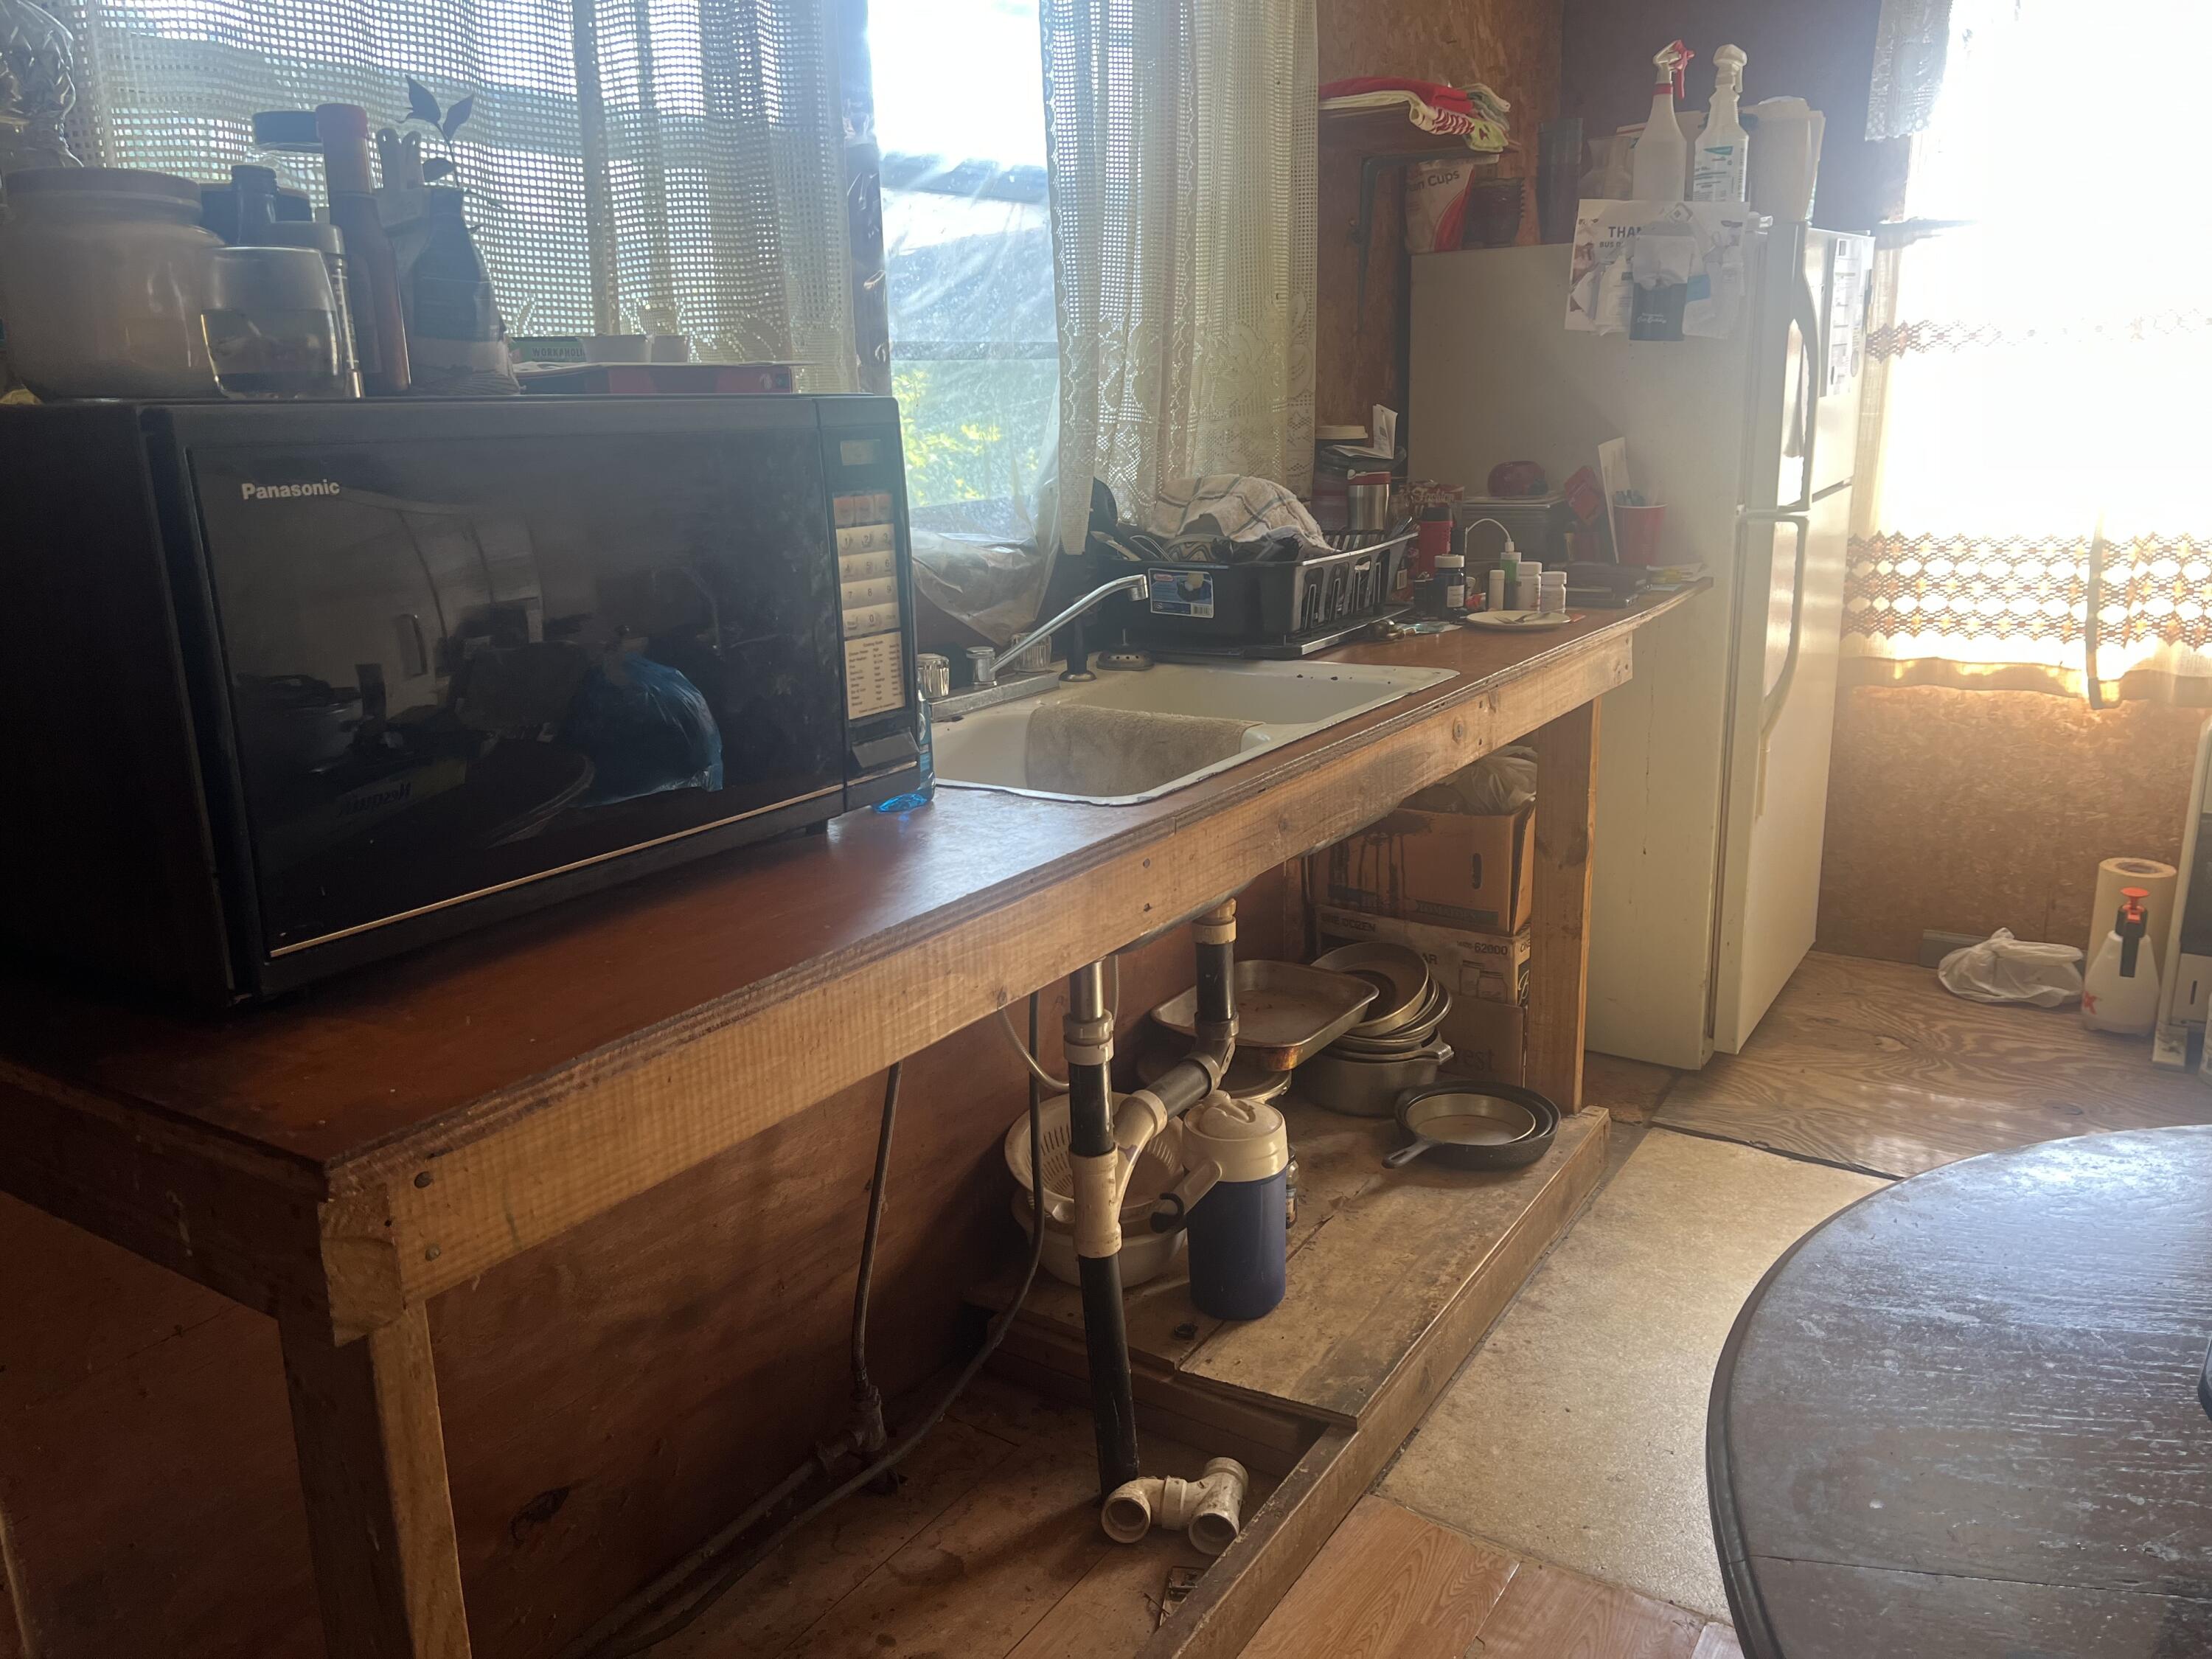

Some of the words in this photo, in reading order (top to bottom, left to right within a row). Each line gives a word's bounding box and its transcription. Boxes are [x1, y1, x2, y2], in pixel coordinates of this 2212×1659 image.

[1427, 170, 1460, 187] Cups
[241, 479, 340, 500] Panasonic
[867, 588, 873, 597] 8
